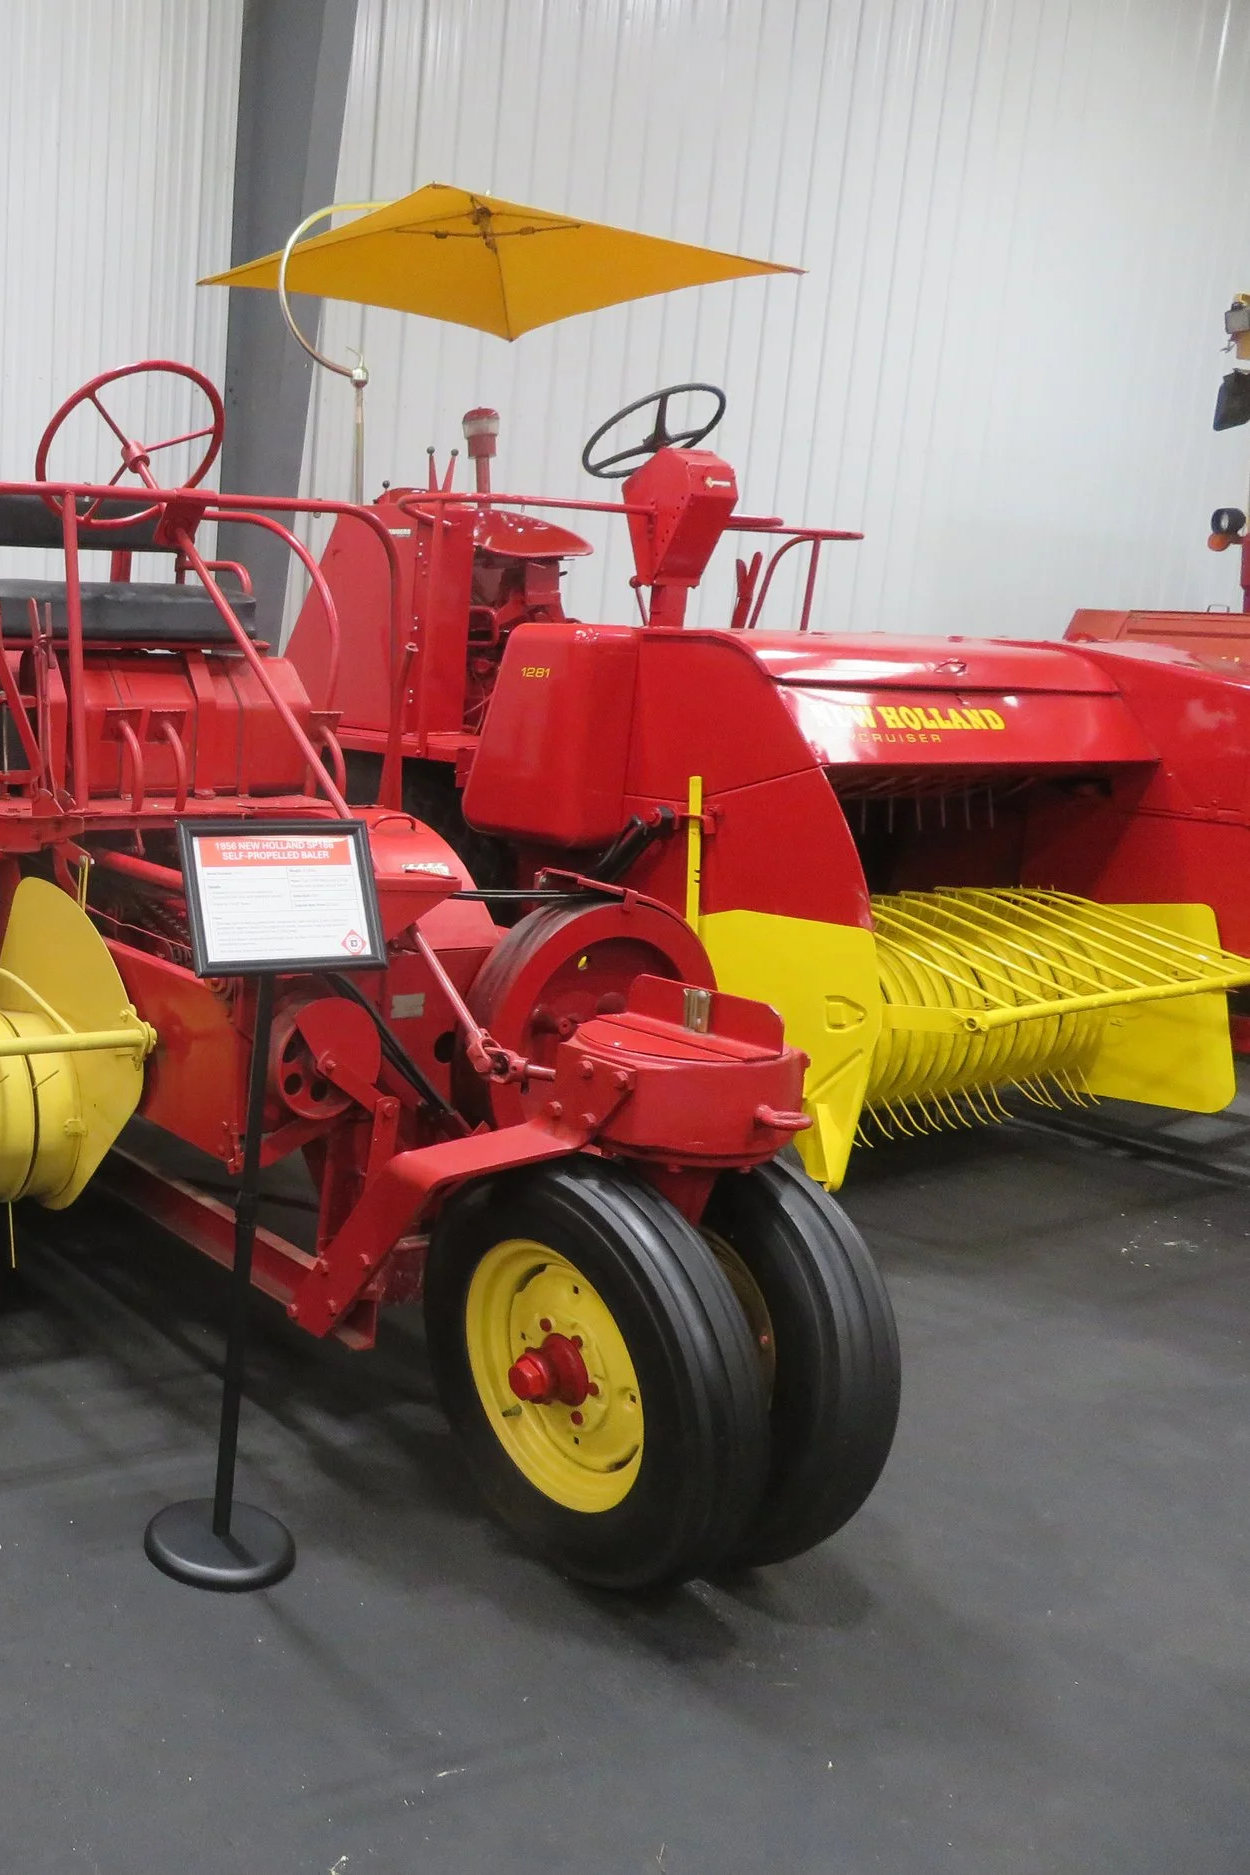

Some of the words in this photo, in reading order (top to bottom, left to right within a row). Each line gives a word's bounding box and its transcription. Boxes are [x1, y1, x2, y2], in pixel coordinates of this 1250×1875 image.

[521, 666, 551, 678] 1281
[877, 706, 1005, 730] HOLLAND
[238, 841, 260, 850] NEW
[262, 840, 305, 850] HOLLAND
[221, 851, 299, 860] SELF-PROPELLED
[302, 850, 330, 859] BALER
